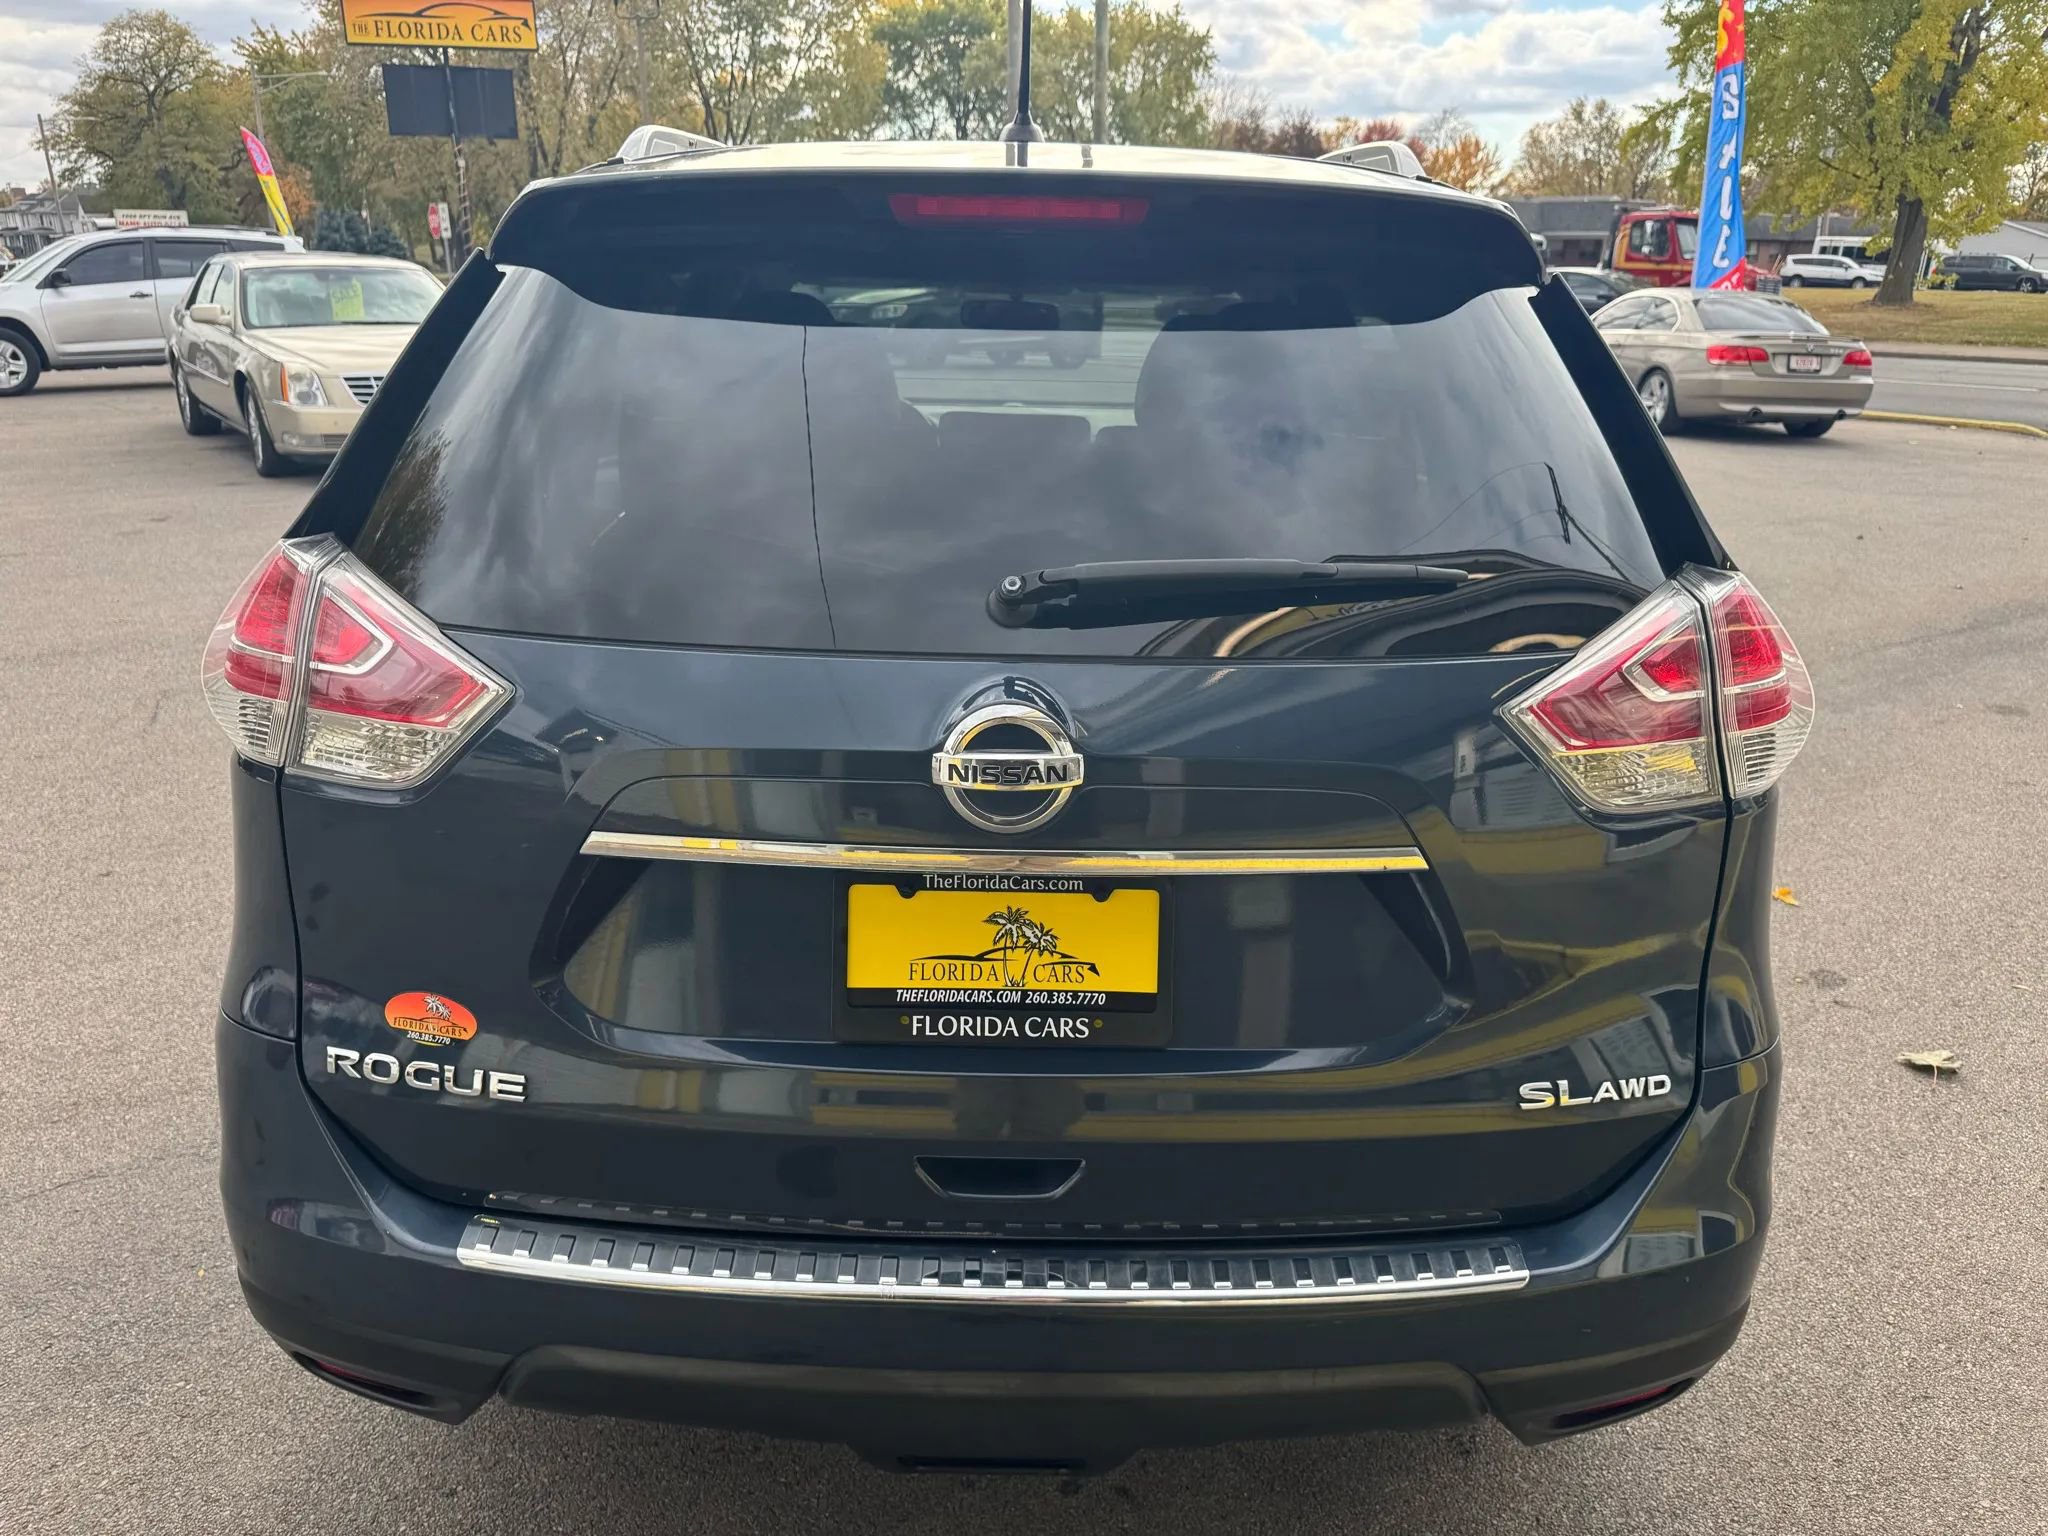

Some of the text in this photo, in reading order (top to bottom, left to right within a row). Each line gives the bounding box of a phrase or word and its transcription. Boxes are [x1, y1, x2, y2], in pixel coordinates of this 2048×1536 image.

[352, 19, 523, 43] THE FLORIDA CARS
[947, 763, 1069, 785] NISSAN
[922, 873, 1084, 891] TheFloridaCars.com
[908, 962, 1085, 984] FLORIDA CARS
[896, 988, 1106, 1006] THEFLORIDACARS.COM 260.385.7770
[393, 1017, 463, 1037] FLORIDA CARS
[407, 1030, 451, 1045] 260.385.7770
[911, 1014, 1090, 1039] FLORIDA CARS
[326, 1045, 527, 1103] ROGUE
